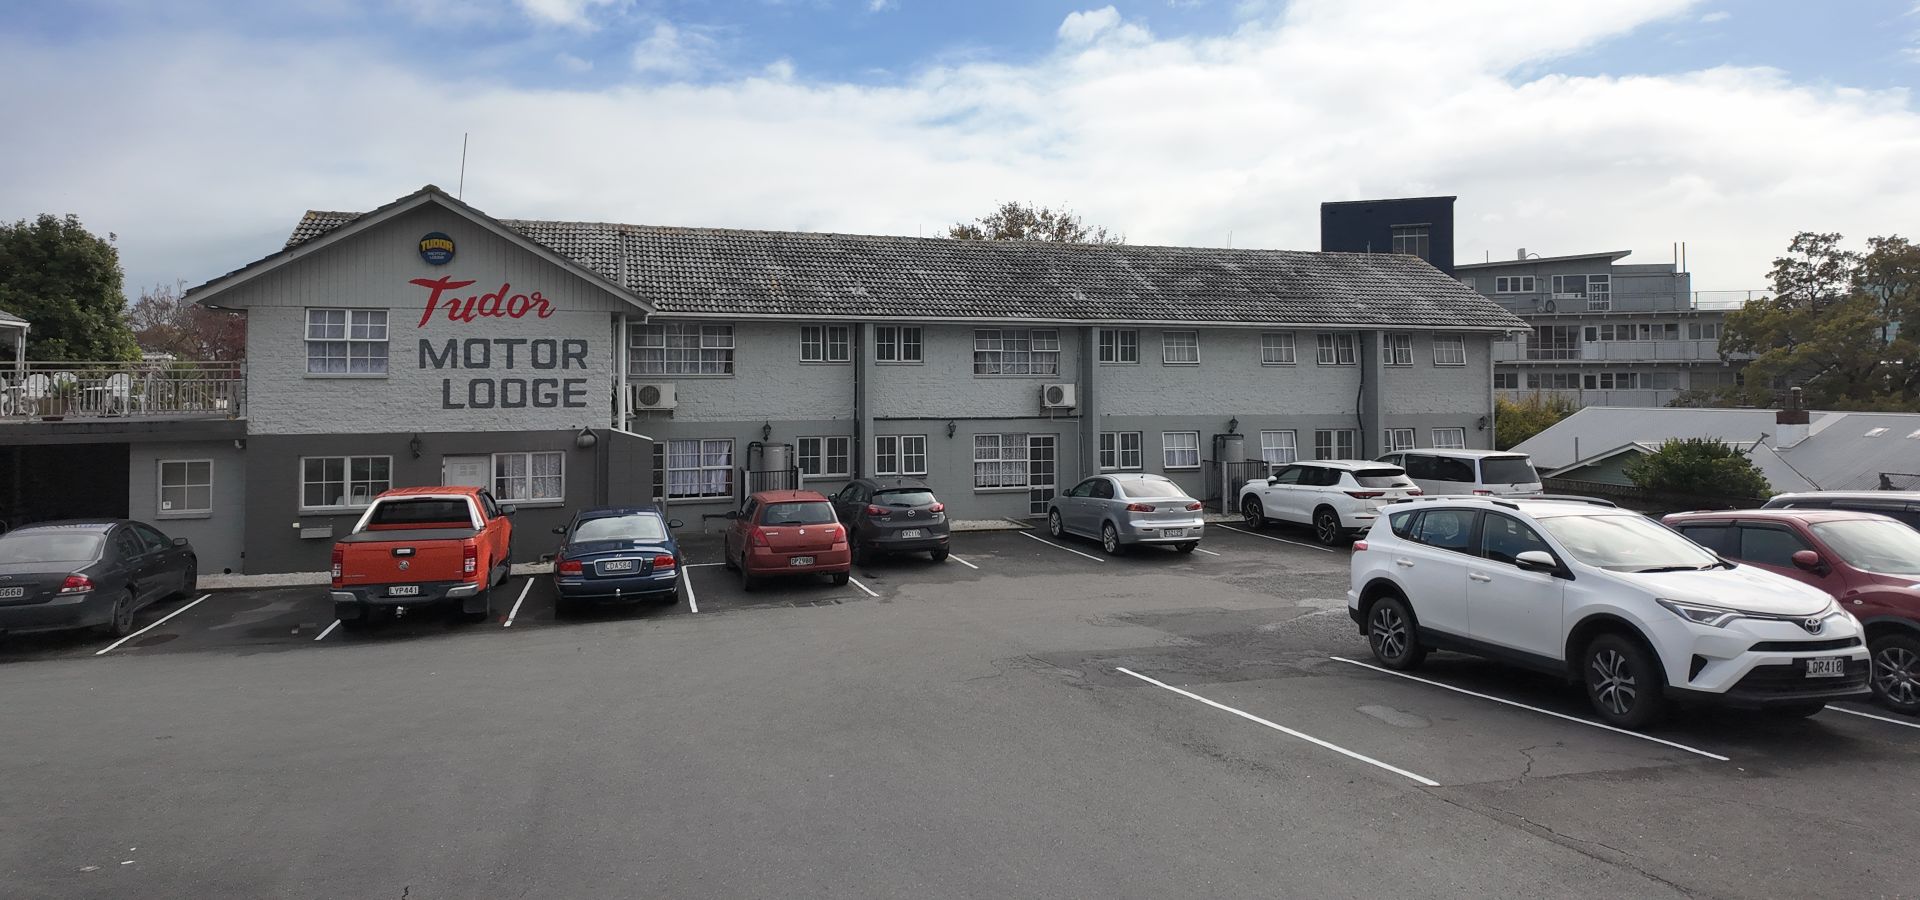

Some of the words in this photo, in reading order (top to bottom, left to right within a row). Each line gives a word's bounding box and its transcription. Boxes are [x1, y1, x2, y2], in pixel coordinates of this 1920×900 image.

[420, 239, 453, 252] TUDOR
[408, 275, 557, 328] Tudor
[419, 338, 588, 369] MOTOR
[442, 378, 587, 409] LODGE
[389, 586, 417, 595] LYP441
